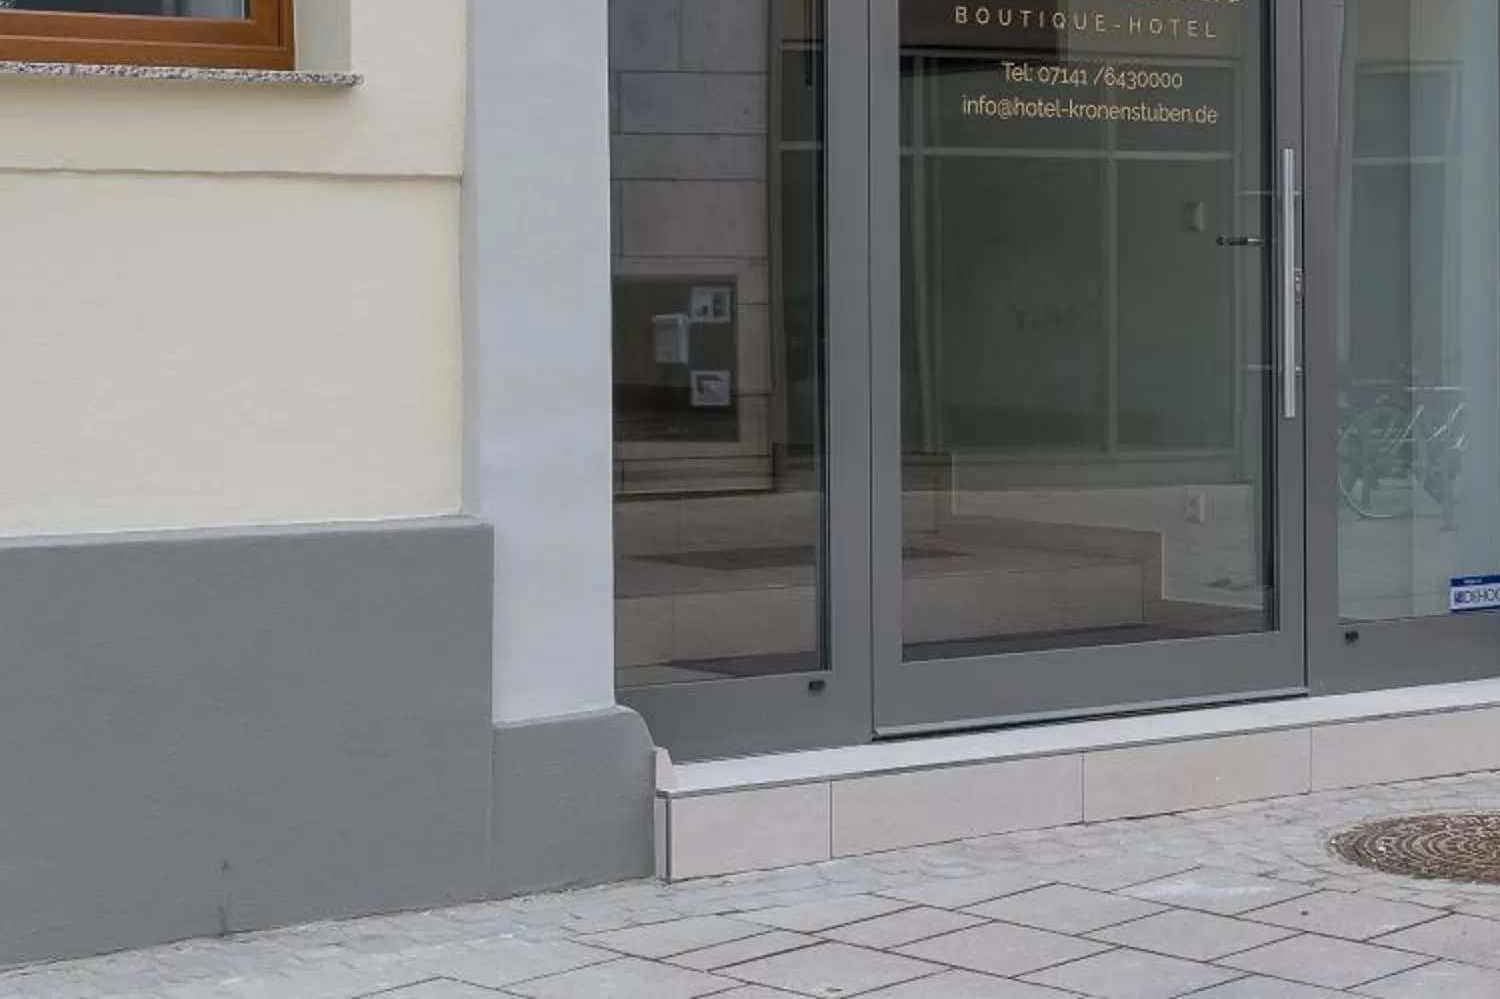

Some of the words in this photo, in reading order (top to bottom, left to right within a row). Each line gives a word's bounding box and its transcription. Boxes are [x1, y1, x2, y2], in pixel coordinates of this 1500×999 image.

[954, 6, 1217, 38] BOUTIQUE-HOTEL
[1038, 65, 1087, 88] 07141
[961, 94, 1218, 125] info@hotel-kronenstuben.de
